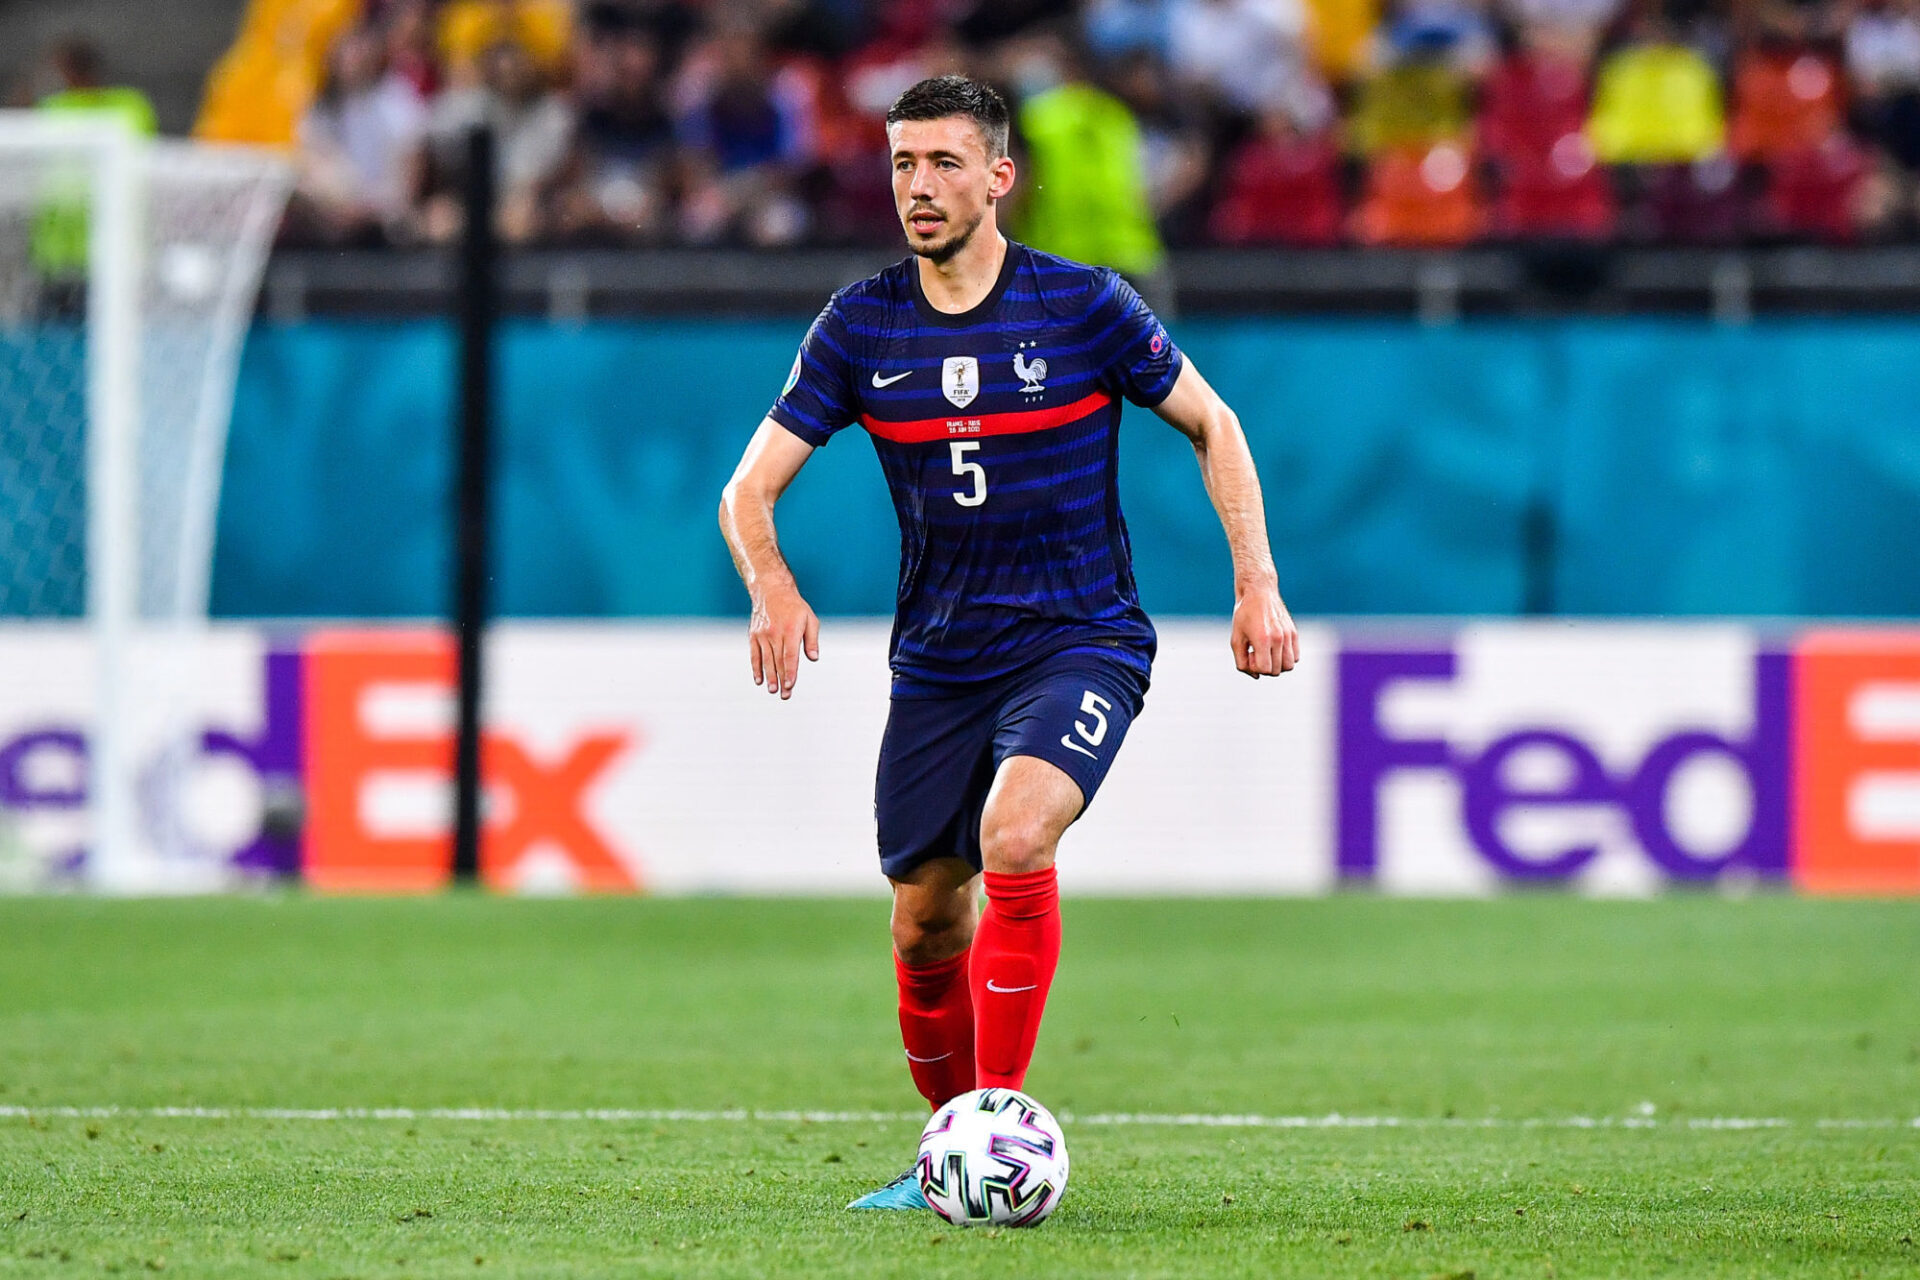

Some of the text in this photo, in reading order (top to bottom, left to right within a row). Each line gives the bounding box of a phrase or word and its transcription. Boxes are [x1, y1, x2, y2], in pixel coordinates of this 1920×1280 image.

[949, 441, 987, 507] 5
[0, 628, 645, 892] edEx
[1074, 690, 1112, 746] 5
[1335, 630, 1920, 890] FedE
